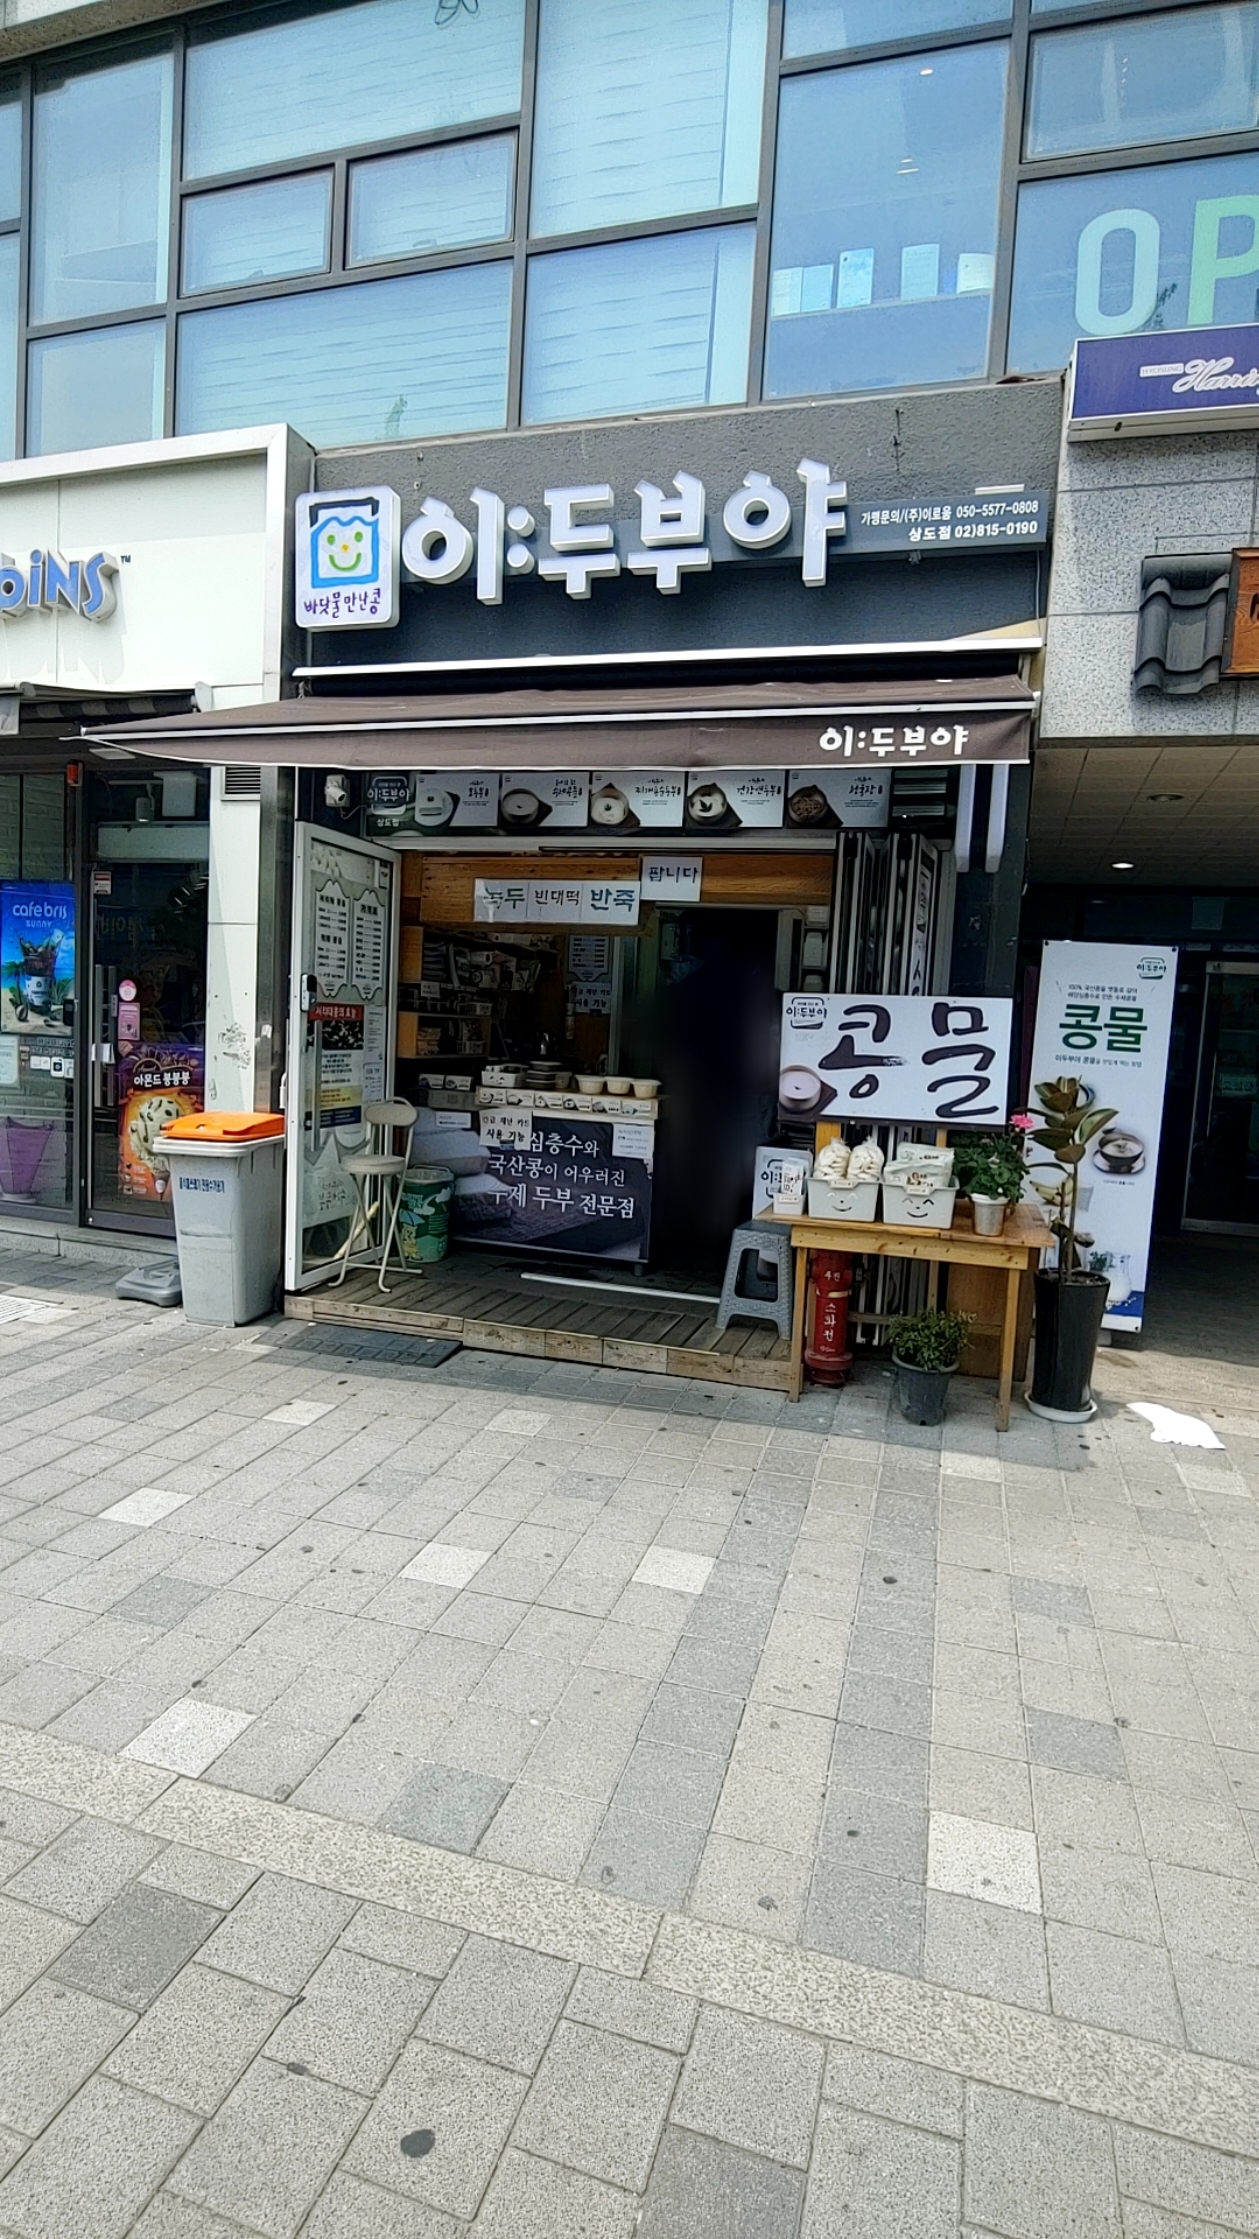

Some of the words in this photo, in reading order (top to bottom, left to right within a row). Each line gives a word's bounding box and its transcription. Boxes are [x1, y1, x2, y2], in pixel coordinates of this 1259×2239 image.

[1172, 357, 1259, 393] Harri
[956, 500, 1038, 519] 050-5577-0808
[908, 526, 950, 541] 상도점
[954, 521, 1038, 539] 02)815-0190
[649, 866, 698, 883] 팝니다
[534, 889, 580, 906] 빈대떡
[590, 887, 635, 912] 반죽
[1059, 1004, 1148, 1052] 콩물
[818, 1002, 999, 1118] 콩물
[134, 1073, 161, 1087] 아몬드
[163, 1071, 190, 1086] 봉봉봉
[488, 1153, 558, 1181] 국산콩이
[564, 1163, 625, 1187] 어우러진
[532, 1186, 575, 1213] 두부
[579, 1193, 634, 1219] 전문점
